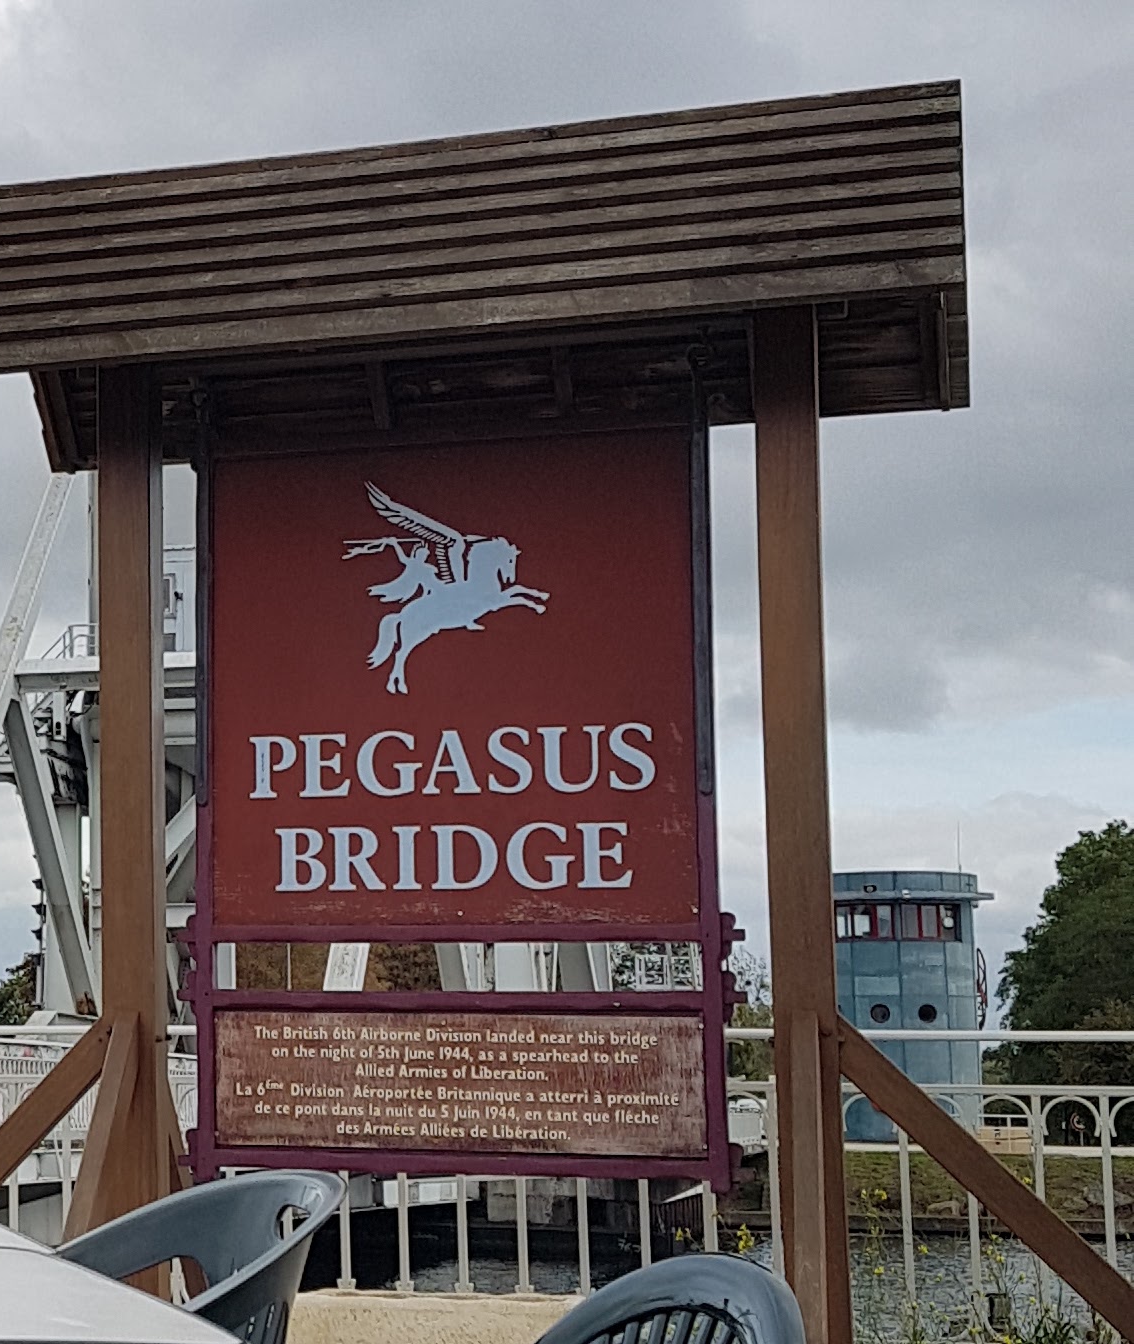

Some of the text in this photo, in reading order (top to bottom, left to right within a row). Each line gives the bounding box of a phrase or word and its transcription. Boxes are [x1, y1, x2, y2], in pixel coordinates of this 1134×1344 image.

[249, 722, 655, 799] PEGASUS
[275, 822, 633, 892] BRIDGE
[254, 1025, 658, 1049] The British 6th Airborne Division landed near this bridge
[272, 1046, 639, 1064] on the night of 5th June 1944, as a spearhead to the
[356, 1065, 548, 1081] Allied Armies of Liberation.
[236, 1083, 252, 1096] La
[291, 1084, 344, 1098] Division
[353, 1085, 433, 1101] Aéroportée
[438, 1086, 521, 1103] Britannique
[526, 1092, 534, 1102] a
[539, 1089, 589, 1103] atterri
[594, 1089, 602, 1104] à
[607, 1091, 680, 1107] proximité
[255, 1101, 271, 1114] de
[276, 1105, 290, 1115] ce
[295, 1104, 327, 1118] pont
[332, 1103, 364, 1116] dans
[368, 1103, 380, 1116] la
[386, 1104, 413, 1117] nuit
[418, 1105, 435, 1118] du
[441, 1106, 448, 1119] 5
[454, 1105, 480, 1122] Juin
[485, 1107, 519, 1122] 1944,
[525, 1111, 542, 1121] en
[547, 1109, 578, 1122] tant
[583, 1113, 610, 1126] que
[337, 1122, 570, 1140] des Armées Alliées de Libération.
